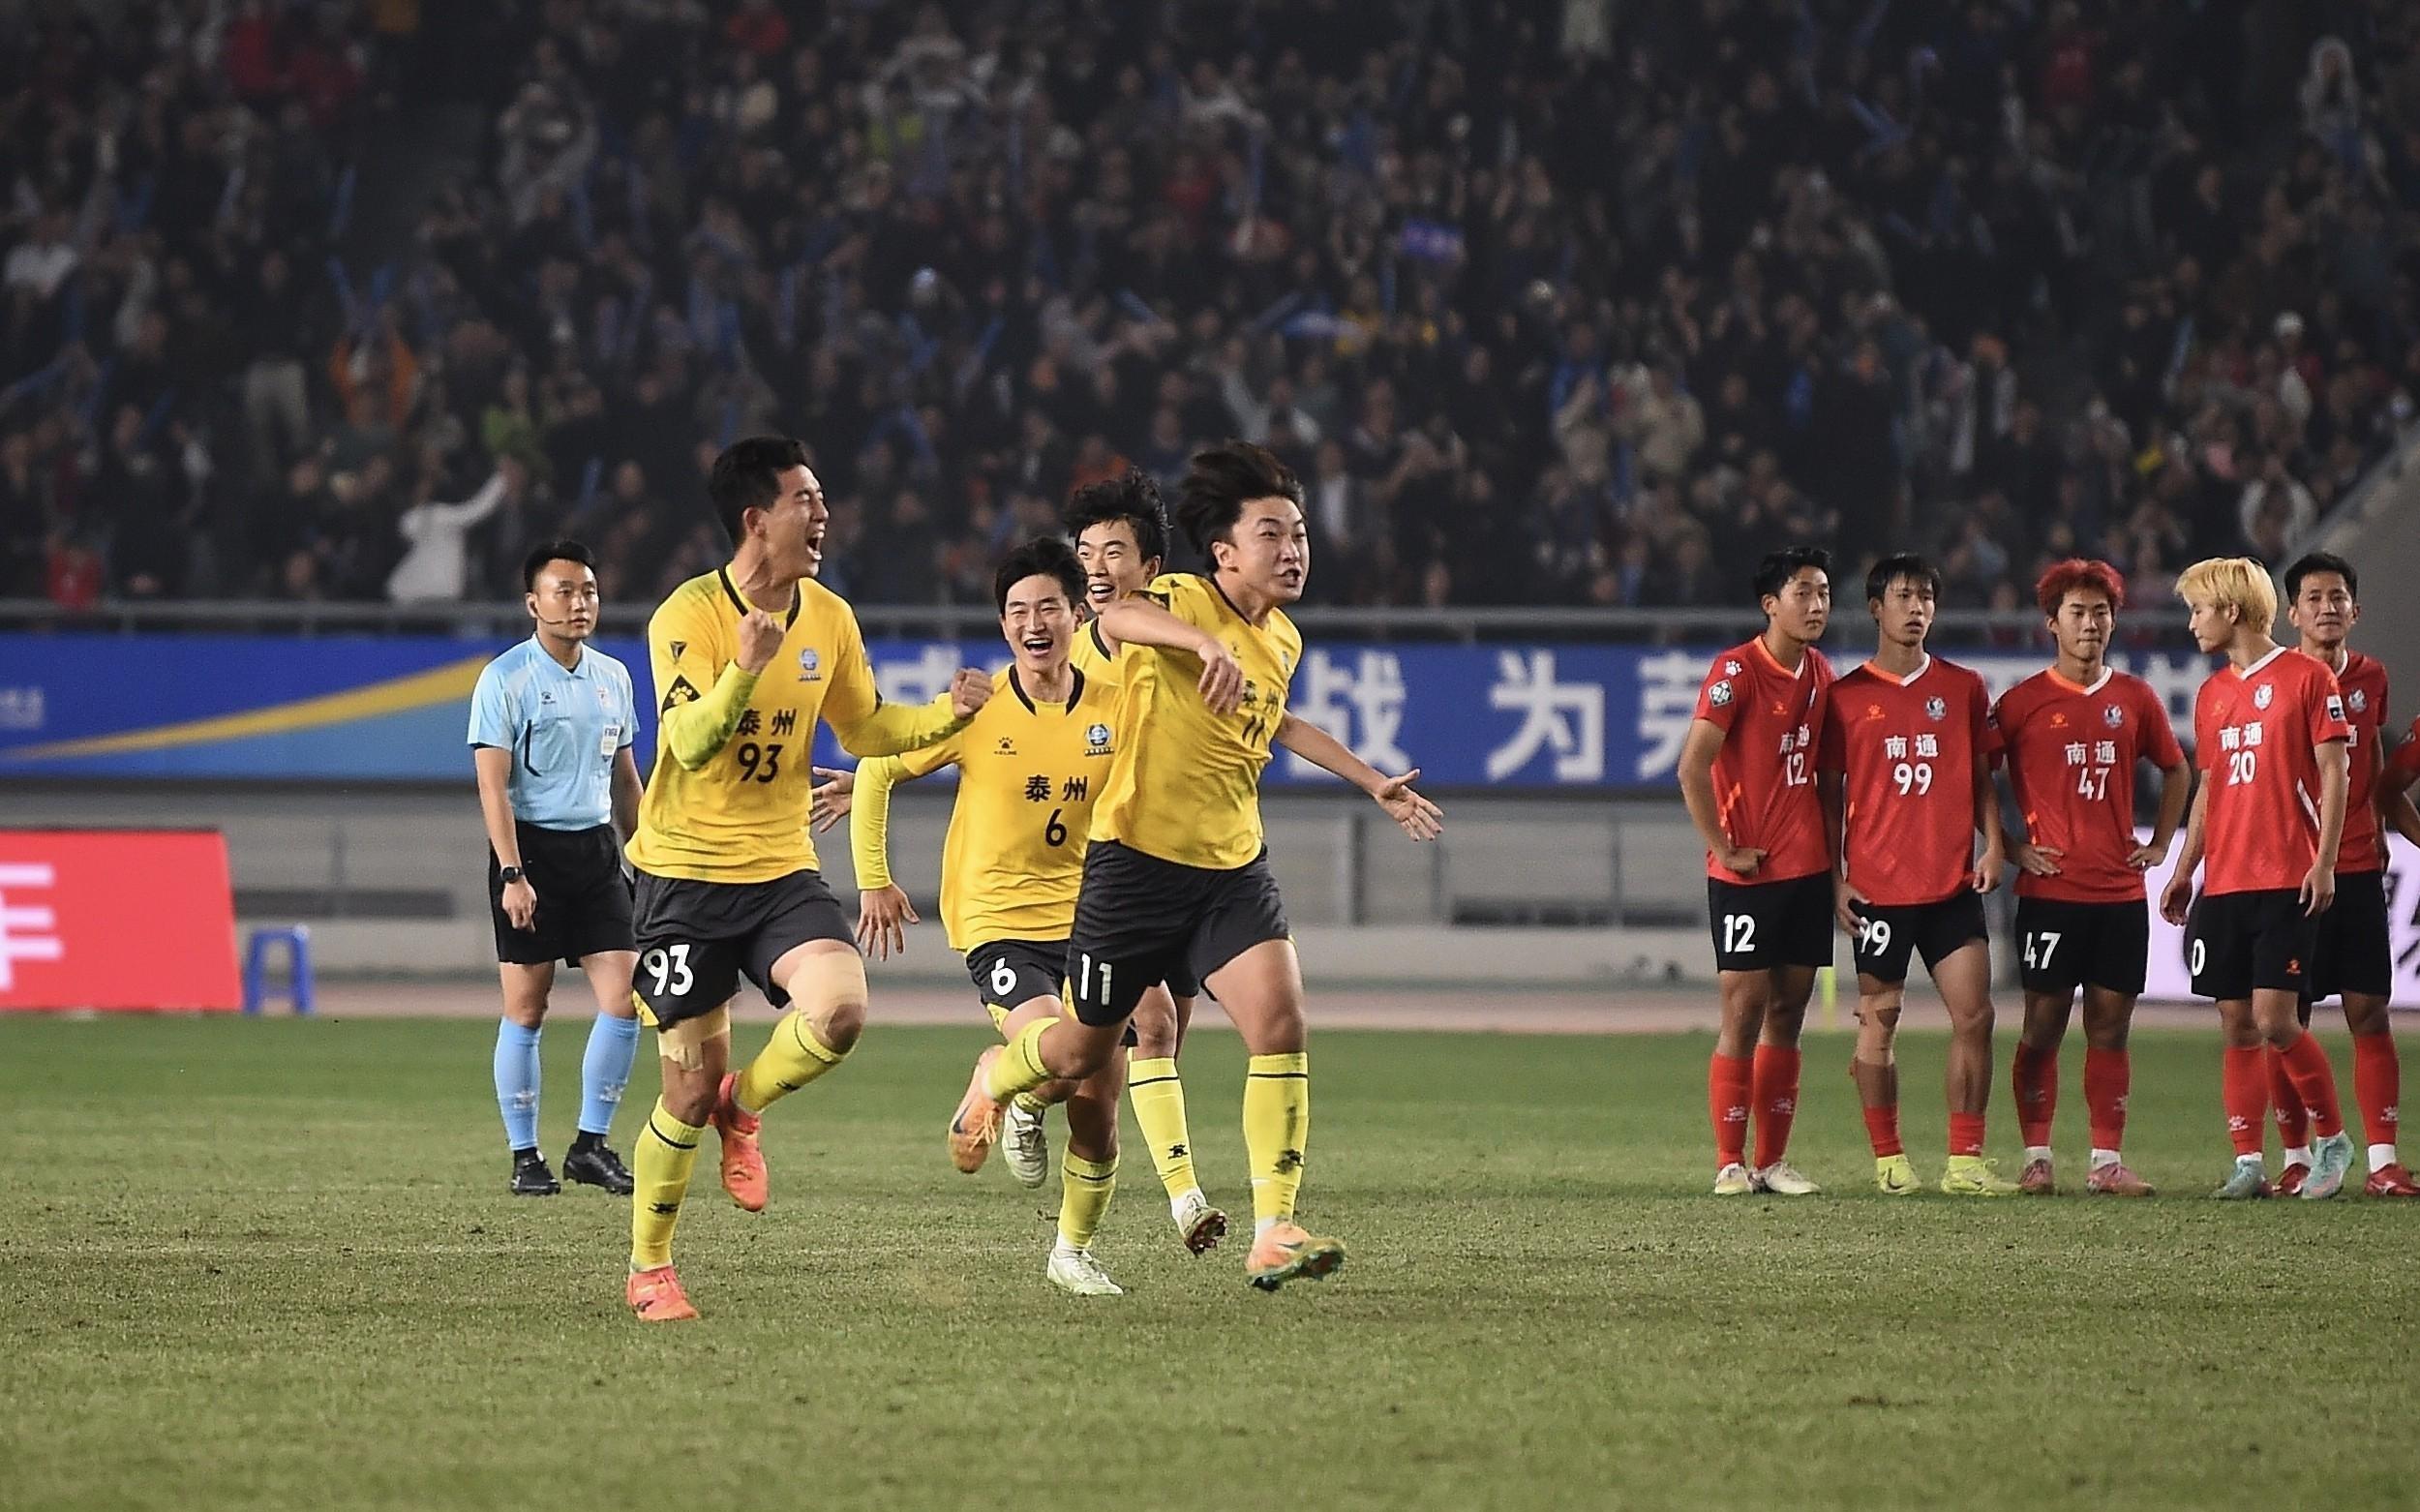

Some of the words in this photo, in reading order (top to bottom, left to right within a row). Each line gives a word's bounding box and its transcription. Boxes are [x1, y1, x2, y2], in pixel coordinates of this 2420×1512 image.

[736, 709, 797, 737] 泰州
[1242, 714, 1265, 749] 11
[2220, 721, 2263, 752] 南通
[738, 741, 784, 783] 93
[1884, 734, 1939, 760] 南通
[2064, 741, 2117, 766] 南通
[1786, 752, 1808, 787] 12
[1893, 762, 1933, 796] 99
[2077, 767, 2110, 801] 47
[2227, 750, 2257, 787] 20
[1024, 773, 1089, 802] 泰州
[1045, 807, 1068, 847] 6
[1723, 914, 1756, 953] 12
[2023, 931, 2062, 970] 47
[643, 944, 694, 996] 93
[990, 956, 1017, 996] 6
[1079, 953, 1113, 1006] 11
